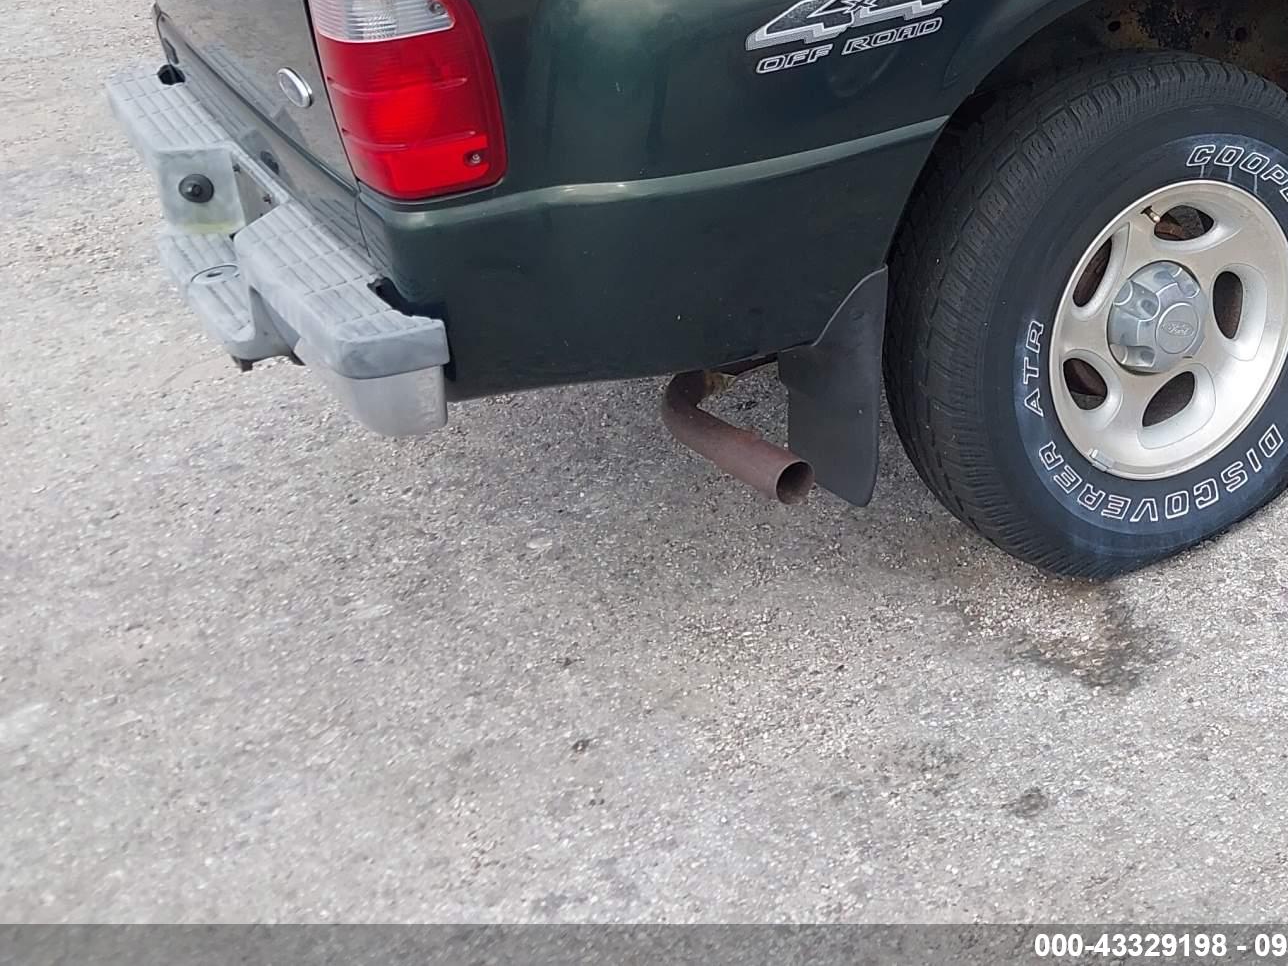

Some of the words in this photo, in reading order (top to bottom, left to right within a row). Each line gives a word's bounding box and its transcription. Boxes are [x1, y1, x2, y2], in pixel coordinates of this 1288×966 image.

[756, 44, 833, 74] OFF
[841, 17, 942, 55] ROAD
[1022, 320, 1044, 418] ATR
[1039, 424, 1285, 523] DISCOVERER
